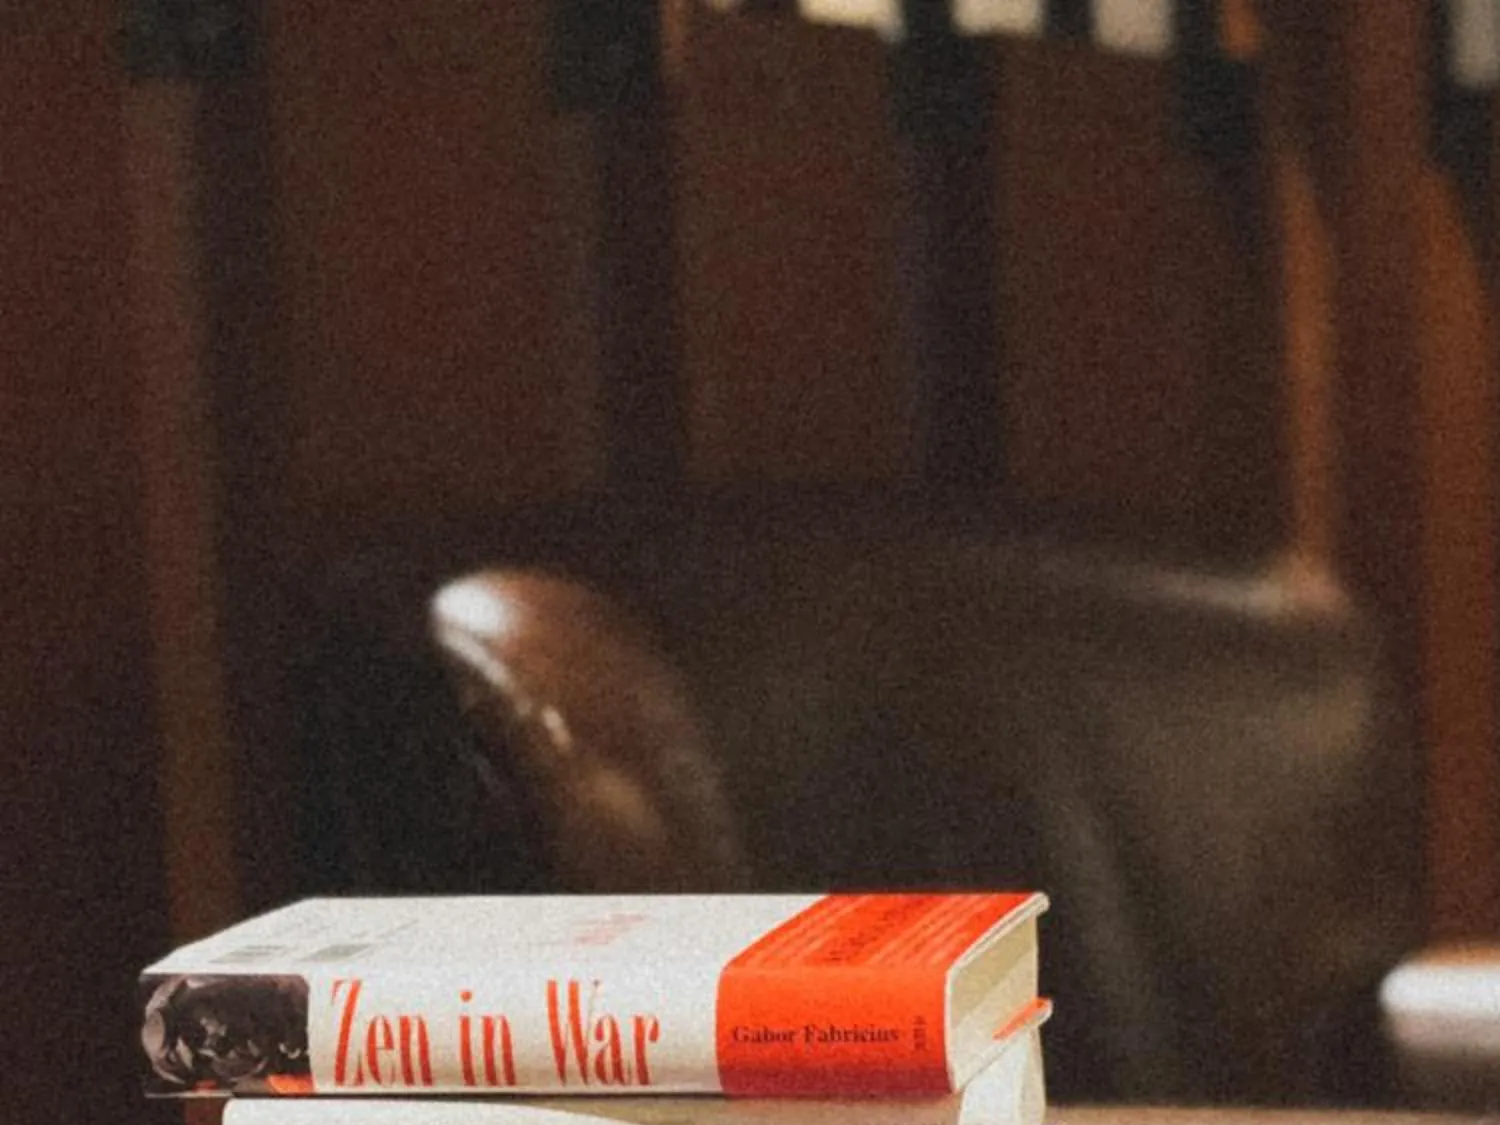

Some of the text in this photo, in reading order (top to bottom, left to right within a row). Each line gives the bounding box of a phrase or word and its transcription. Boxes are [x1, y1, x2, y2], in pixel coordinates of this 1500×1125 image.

[332, 978, 661, 1088] Zen in War
[732, 1025, 795, 1044] Gabor
[804, 1023, 899, 1044] Fabricius
